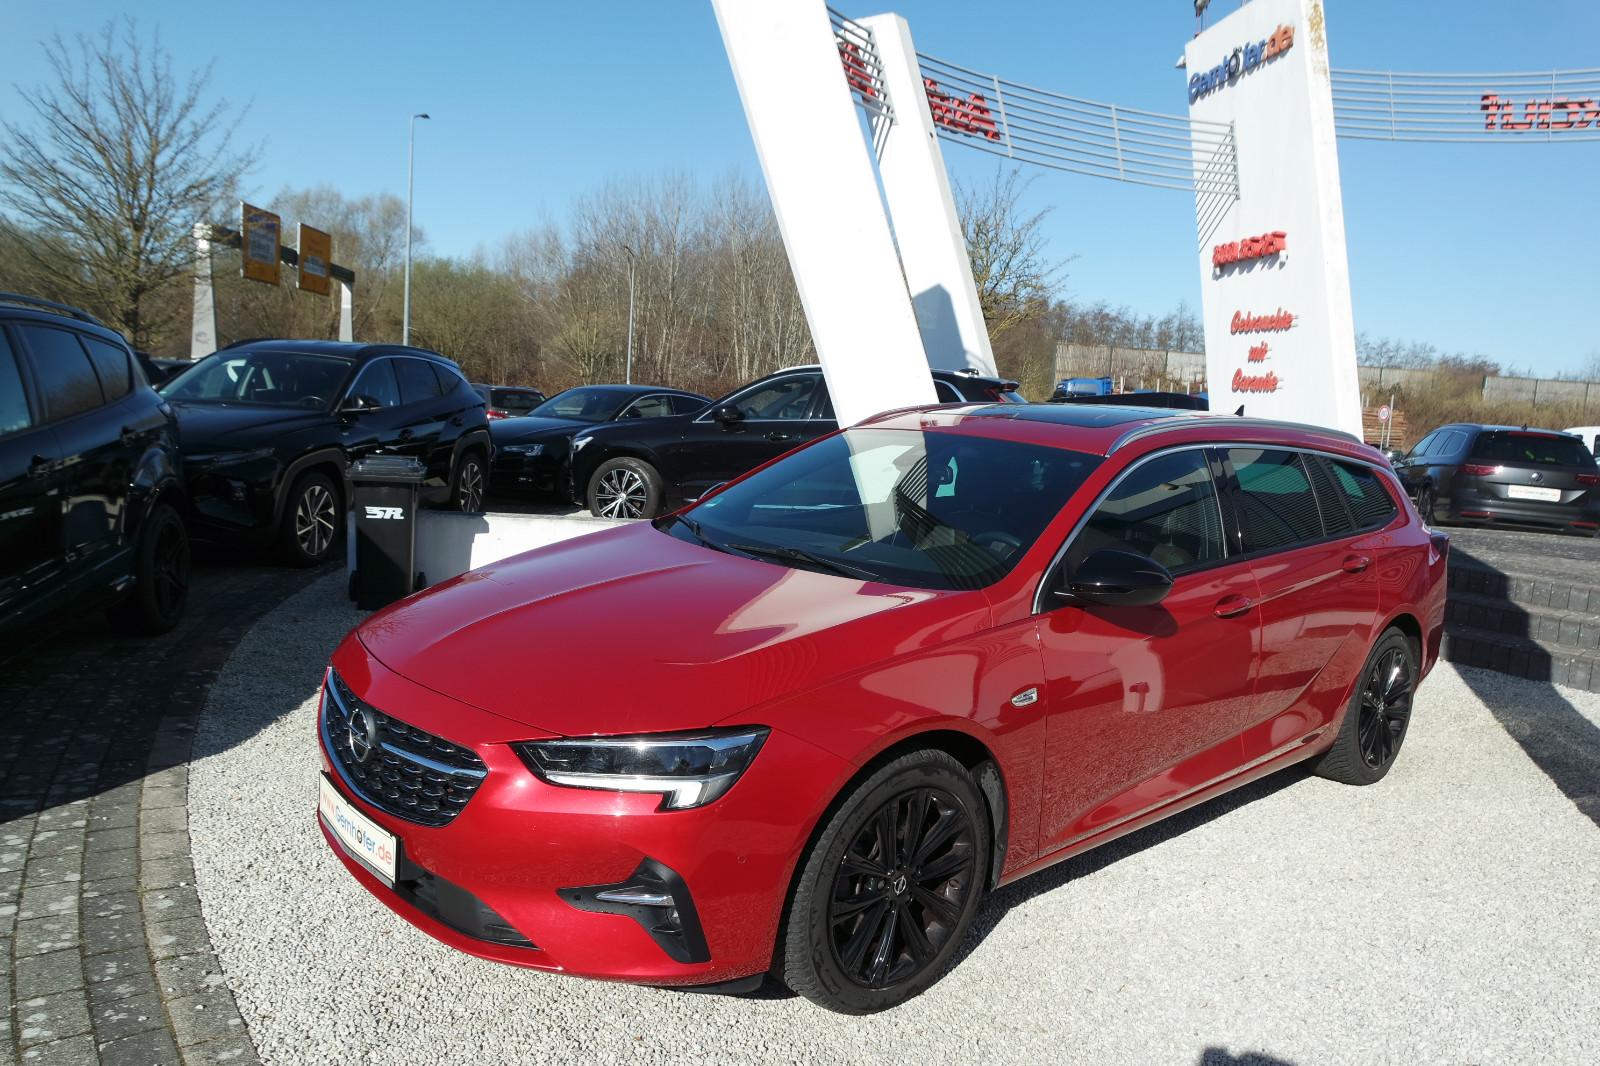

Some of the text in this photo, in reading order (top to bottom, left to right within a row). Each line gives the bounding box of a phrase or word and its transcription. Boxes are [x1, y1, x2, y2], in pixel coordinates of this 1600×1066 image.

[1230, 307, 1294, 335] Gebrauchte
[1247, 340, 1269, 363] mit
[1231, 368, 1279, 393] Garantie
[364, 506, 405, 520] SR
